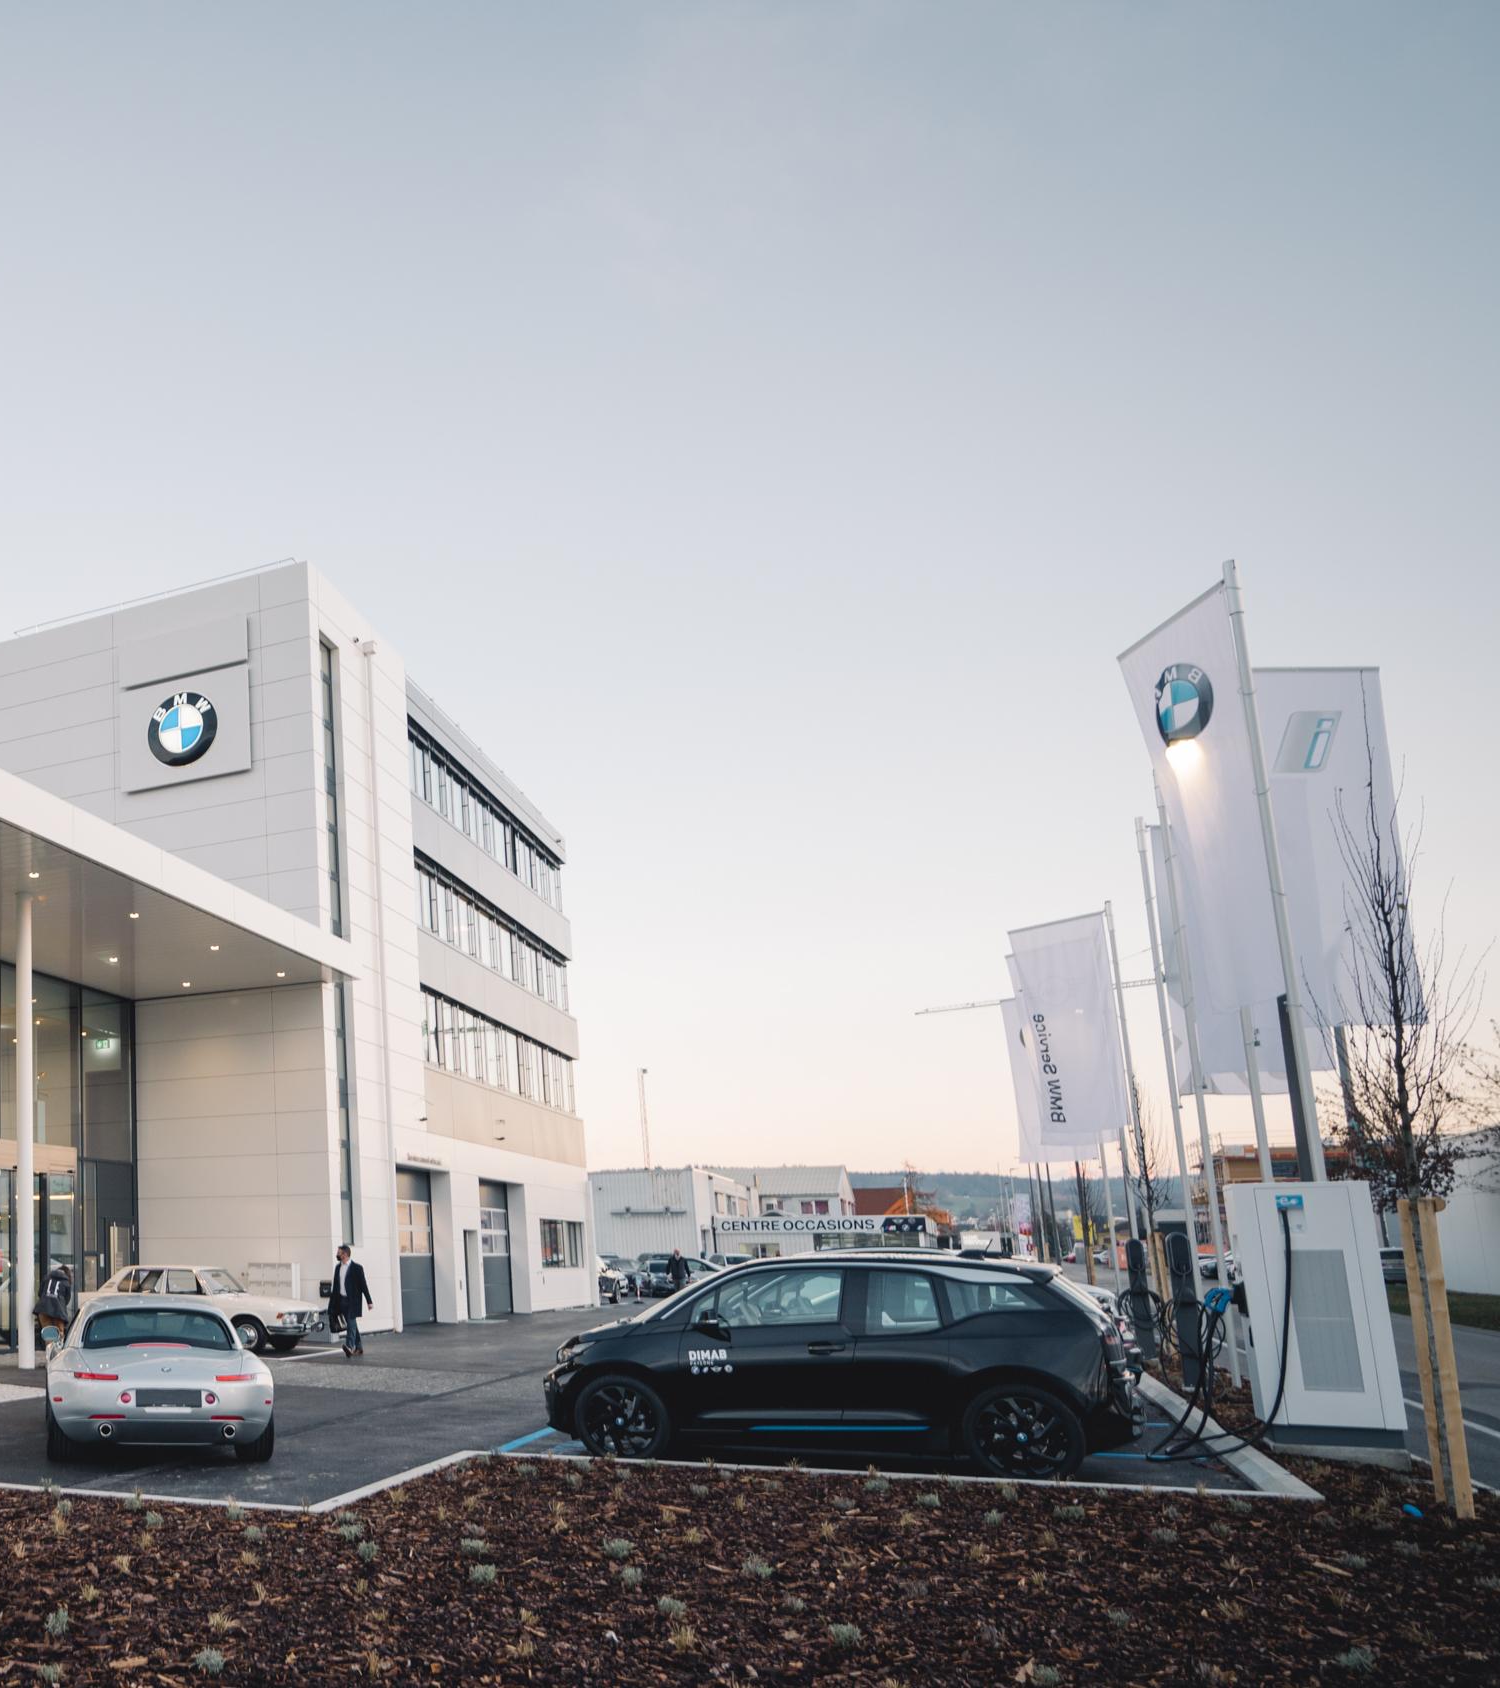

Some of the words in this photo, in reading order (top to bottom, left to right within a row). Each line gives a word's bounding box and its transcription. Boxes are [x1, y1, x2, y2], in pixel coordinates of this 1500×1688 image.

[153, 692, 212, 722] BMW
[721, 1220, 779, 1231] CENTRE
[783, 1219, 875, 1230] OCCASIONS
[688, 1349, 727, 1361] DIMAB
